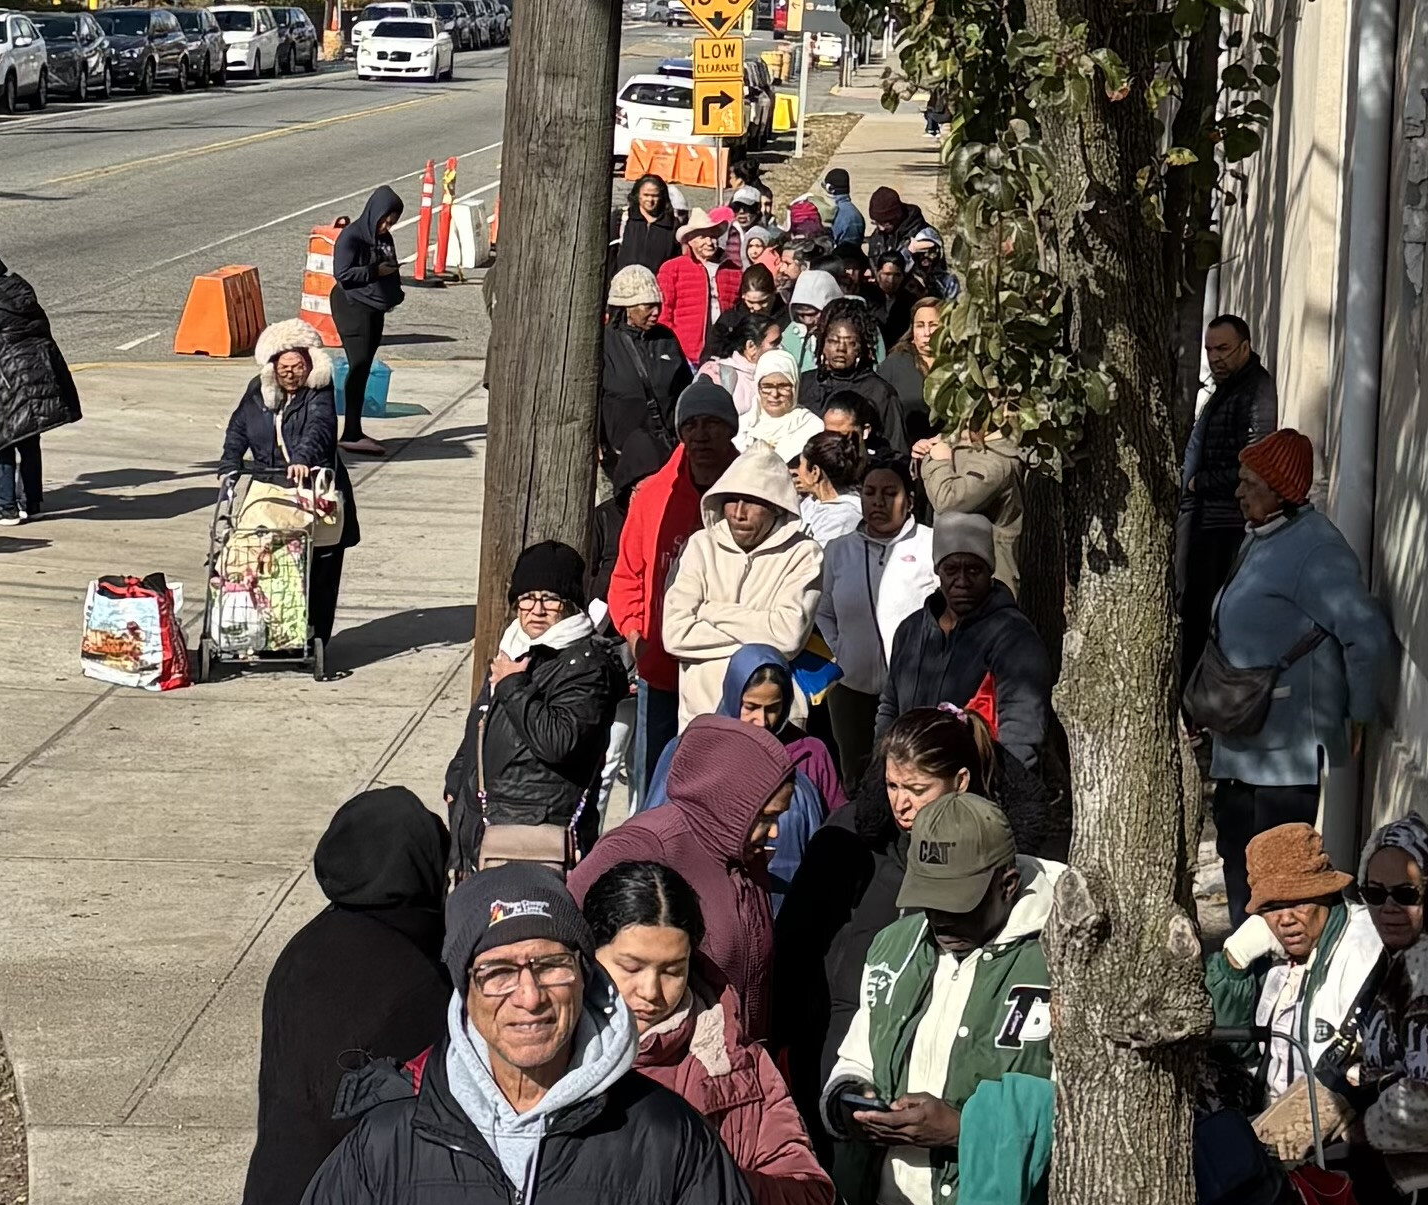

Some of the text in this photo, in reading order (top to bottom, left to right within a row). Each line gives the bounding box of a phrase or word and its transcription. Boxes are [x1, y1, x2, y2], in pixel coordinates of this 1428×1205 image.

[701, 43, 736, 59] LOW
[696, 63, 740, 73] CLEARANCE
[919, 840, 951, 865] CAT
